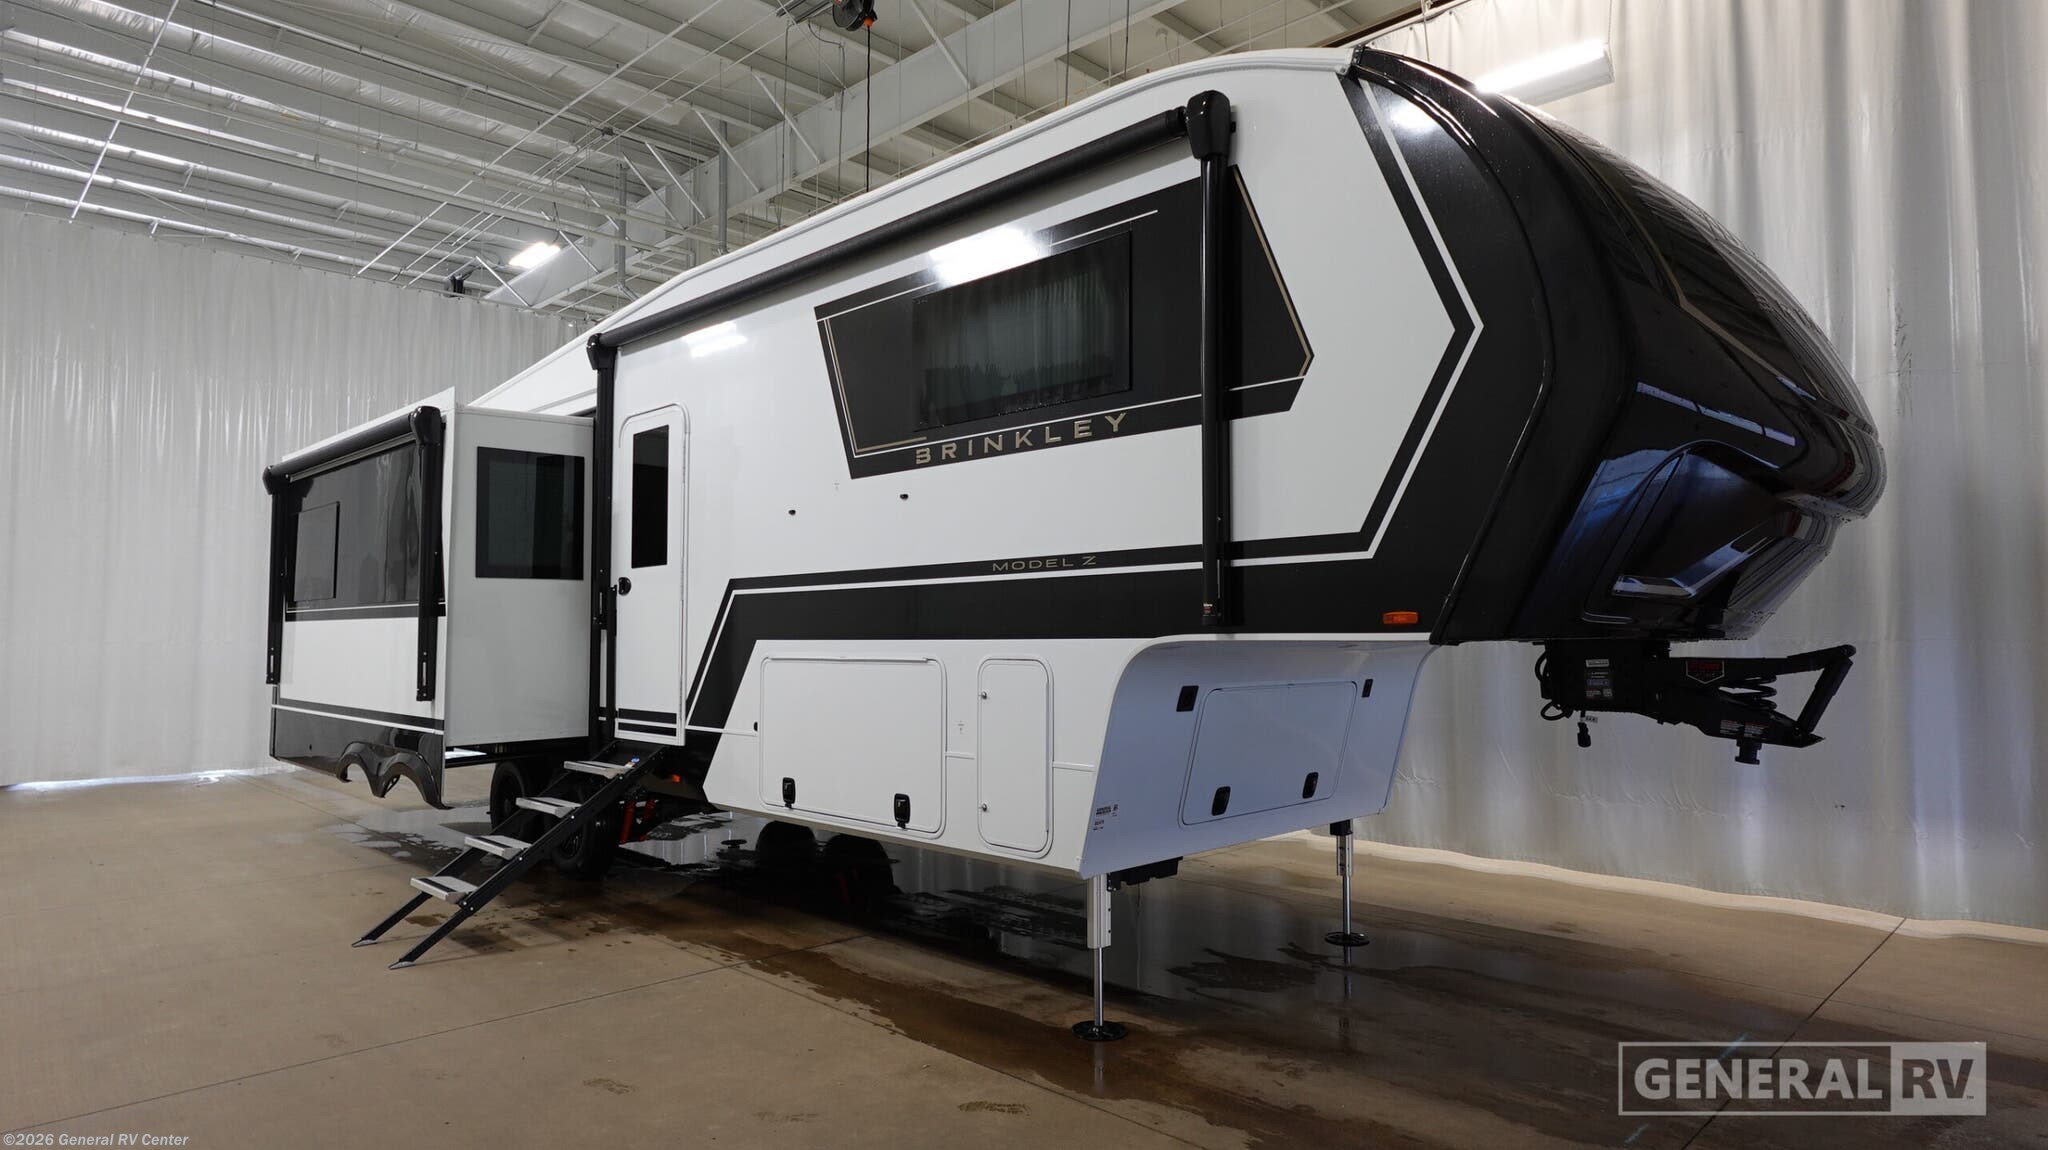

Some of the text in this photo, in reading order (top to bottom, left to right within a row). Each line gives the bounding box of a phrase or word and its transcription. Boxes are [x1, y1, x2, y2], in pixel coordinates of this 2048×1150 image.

[915, 412, 1127, 464] BRINKLEY
[992, 556, 1096, 572] MODEL Z
